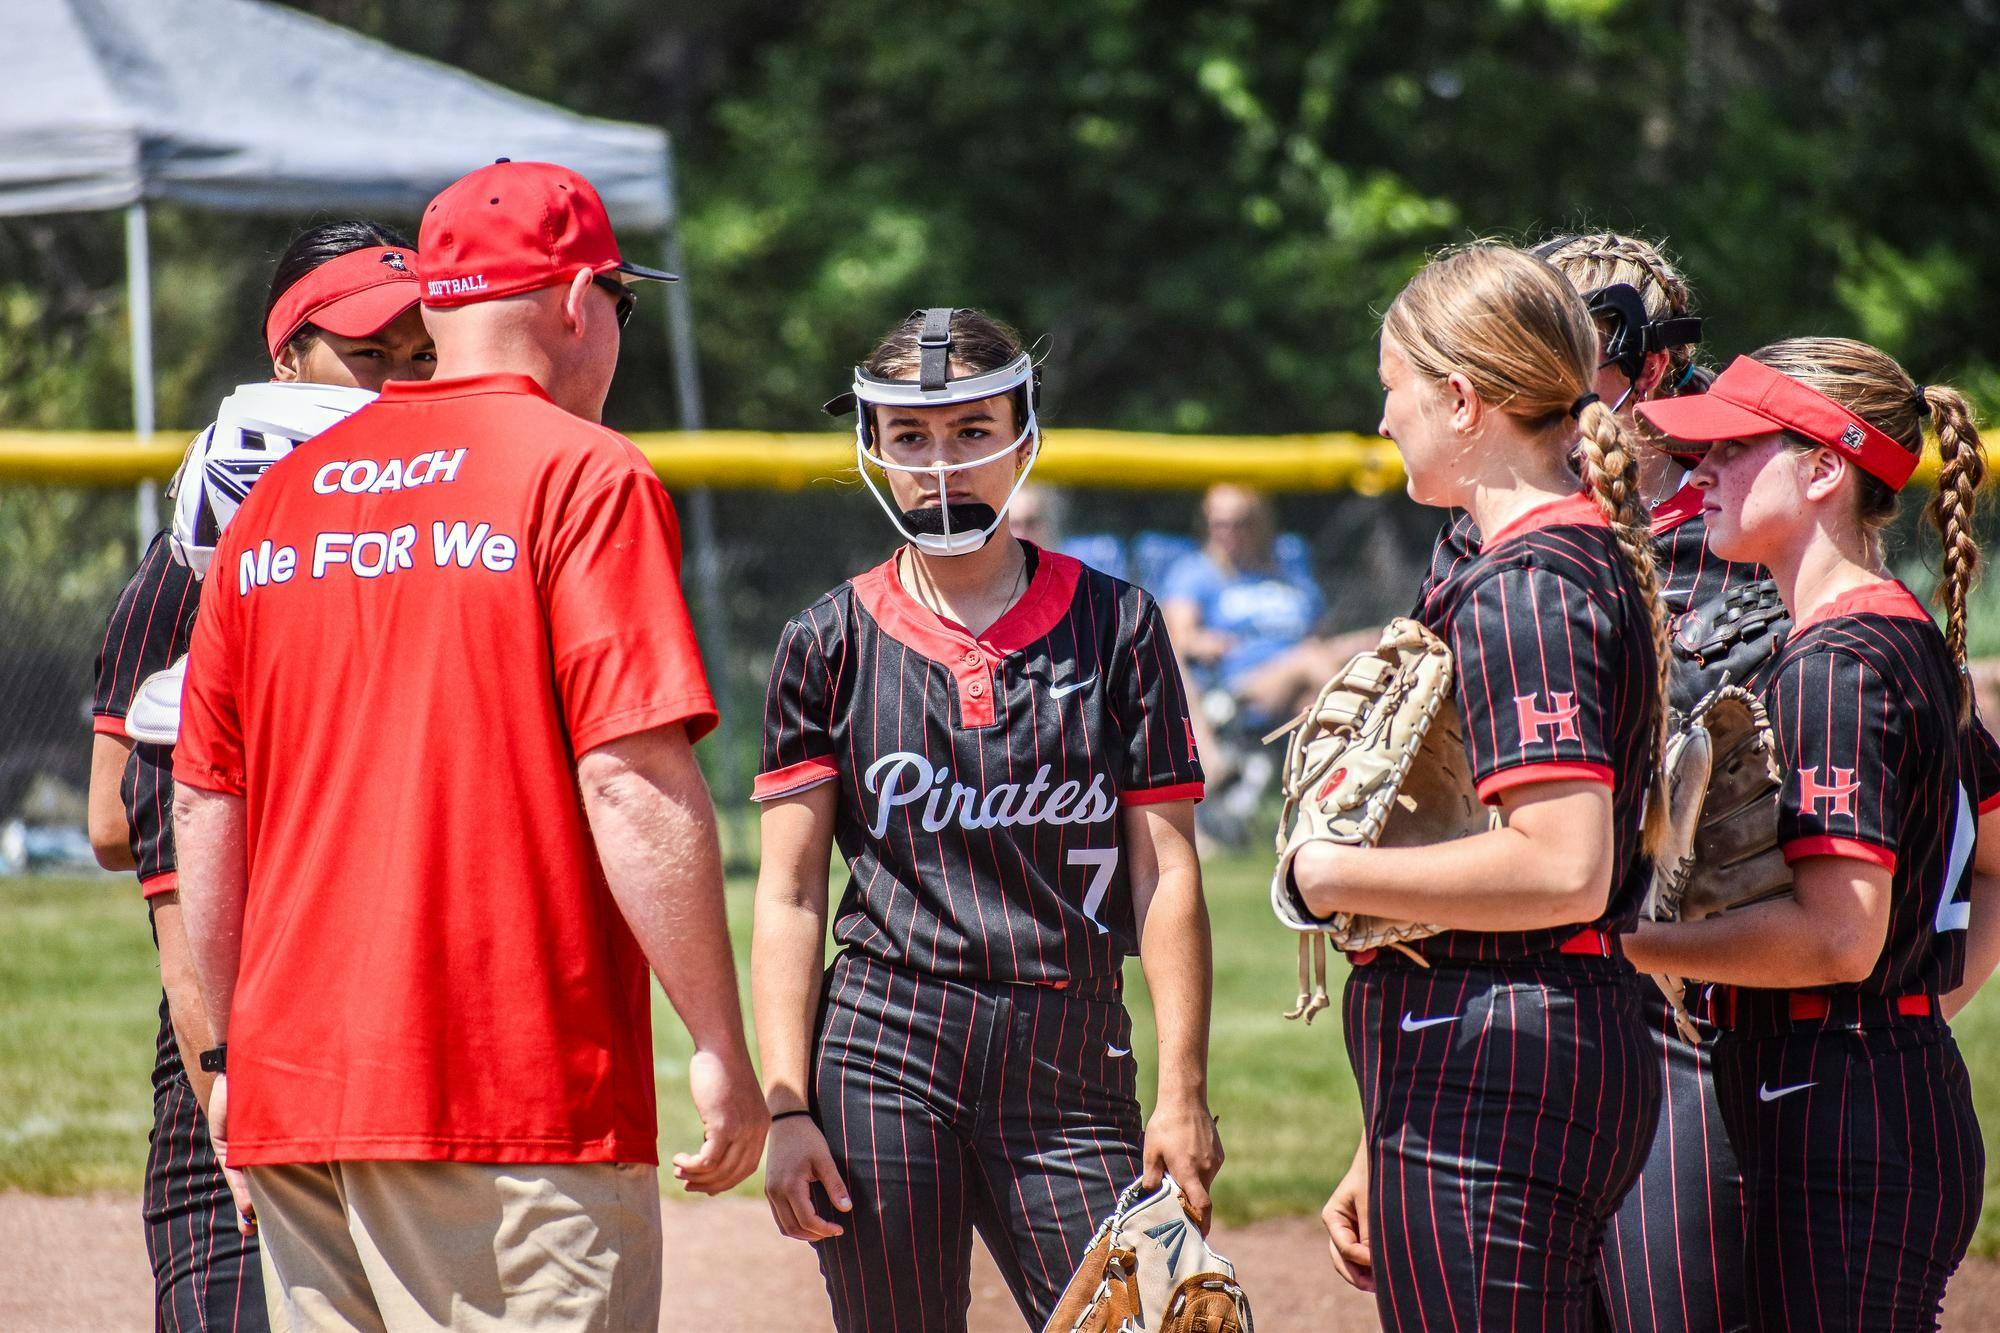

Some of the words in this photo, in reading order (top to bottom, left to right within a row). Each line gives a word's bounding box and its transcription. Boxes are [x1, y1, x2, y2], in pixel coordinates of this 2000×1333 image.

[427, 275, 488, 296] SOFTBALL
[312, 447, 468, 494] COACH
[311, 523, 417, 579] FOR
[432, 520, 517, 572] We
[1513, 691, 1581, 746] H
[864, 751, 1118, 840] Pirates
[1797, 765, 1861, 817] H
[1066, 847, 1119, 935] 7
